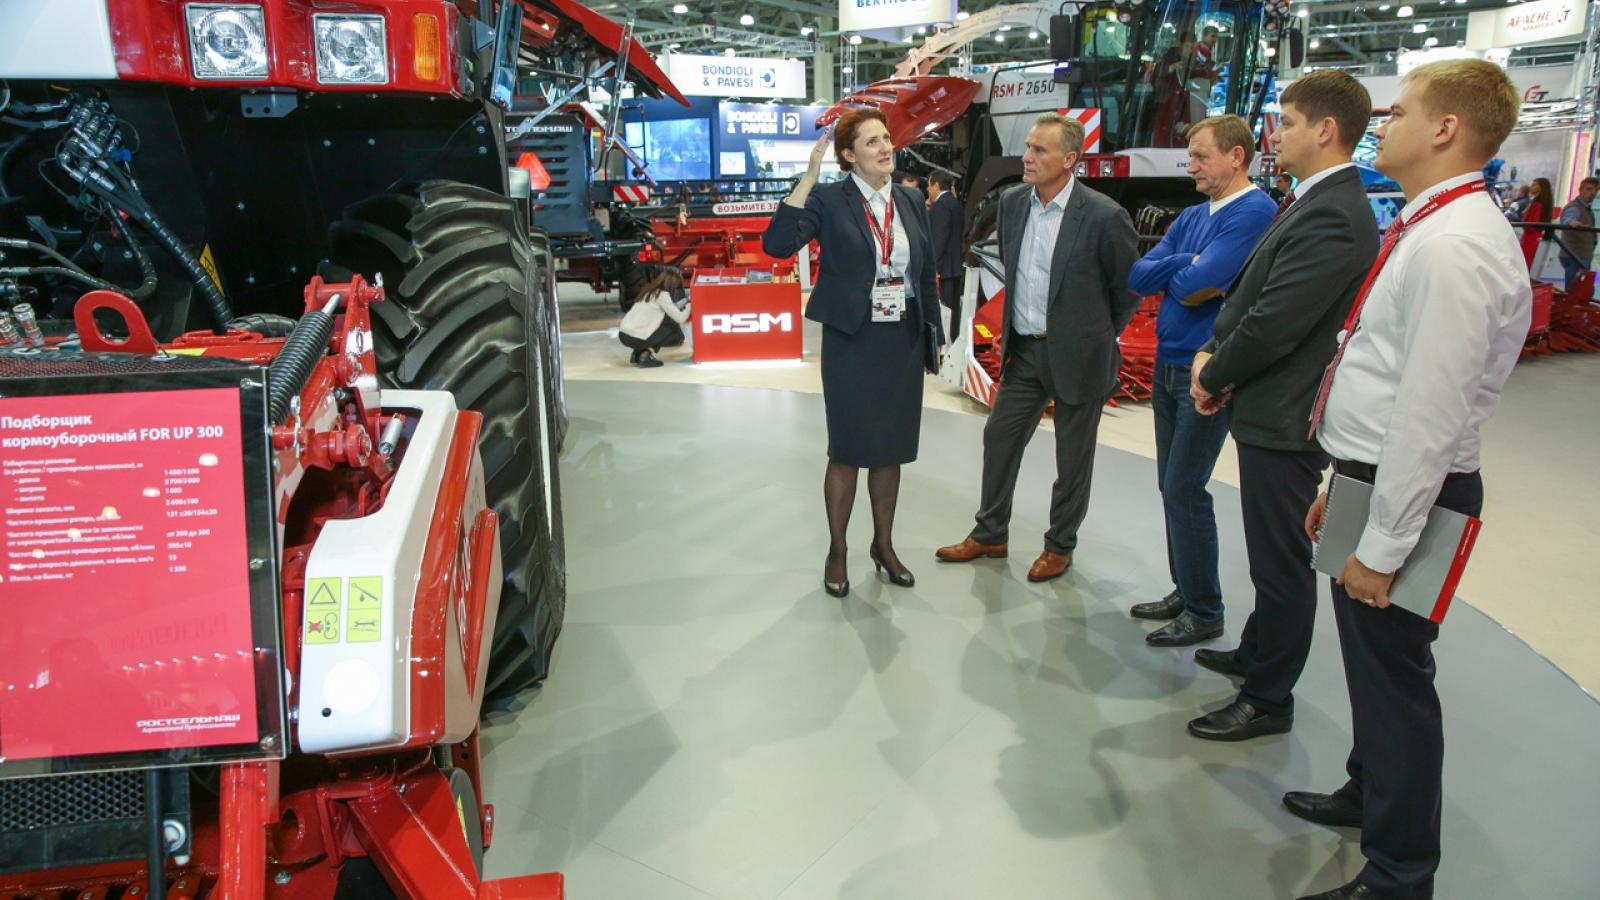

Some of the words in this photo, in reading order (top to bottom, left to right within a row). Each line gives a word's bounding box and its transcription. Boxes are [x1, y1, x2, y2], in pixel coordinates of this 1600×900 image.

[702, 65, 753, 75] BONDIOLI
[703, 78, 710, 87] &
[717, 77, 753, 87] PAVESI
[992, 83, 1015, 98] RSM
[1016, 82, 1025, 96] F
[1025, 79, 1056, 95] 2650
[717, 203, 766, 213] ВОЗЬМИТЕ
[702, 312, 792, 334] RSM
[1, 414, 92, 430] Подборщик
[2, 430, 137, 449] кормоуборочный
[140, 427, 170, 441] FOR
[173, 426, 194, 440] UP
[196, 425, 224, 439] 300
[136, 714, 240, 727] РОСТСЕЛЬМАШ
